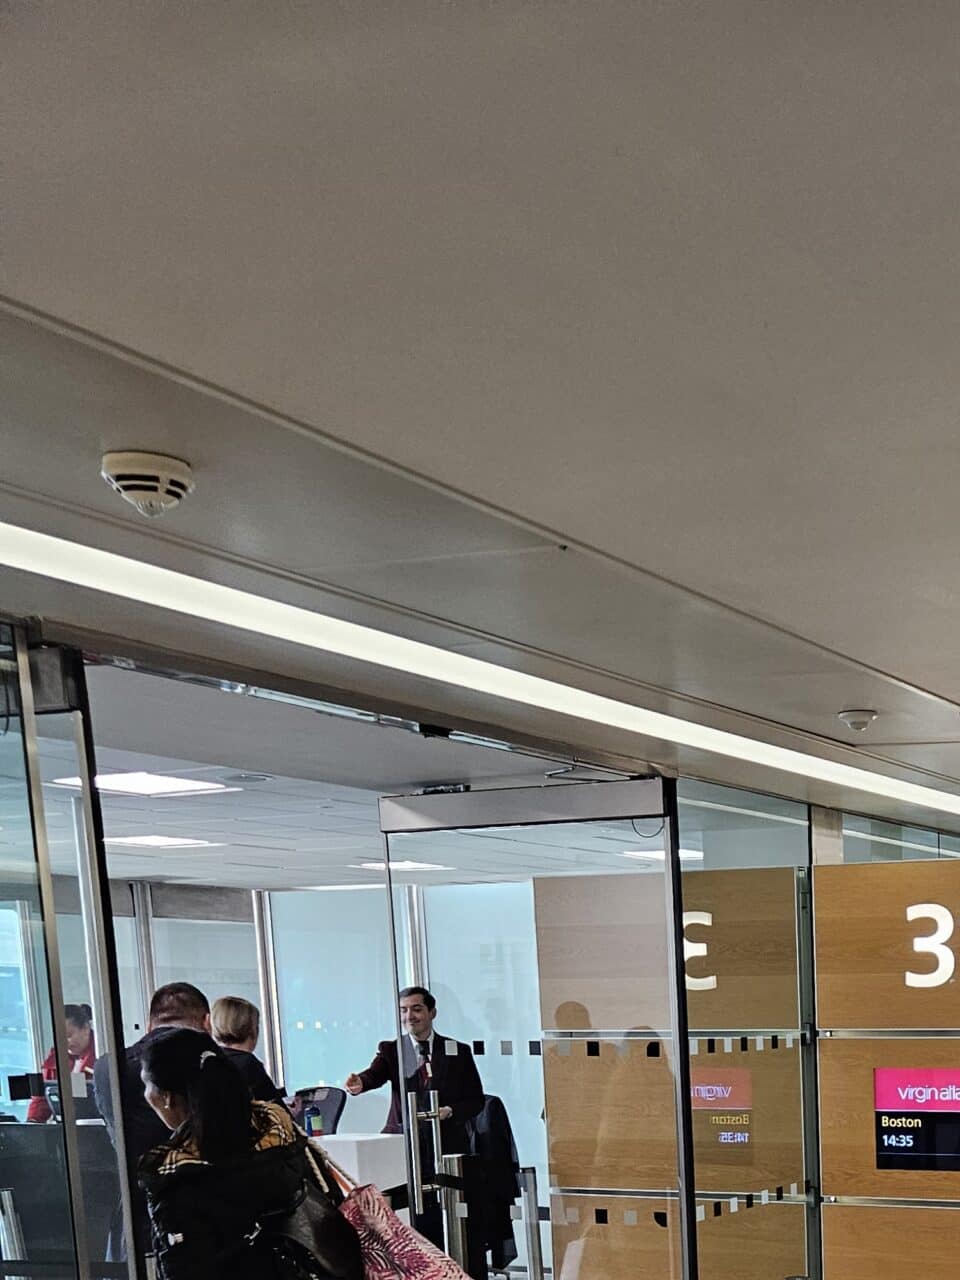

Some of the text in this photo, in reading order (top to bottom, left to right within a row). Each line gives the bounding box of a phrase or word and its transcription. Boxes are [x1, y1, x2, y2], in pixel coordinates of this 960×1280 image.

[897, 1084, 939, 1103] virgin
[881, 1115, 922, 1128] Boston
[882, 1134, 914, 1147] 14:35
